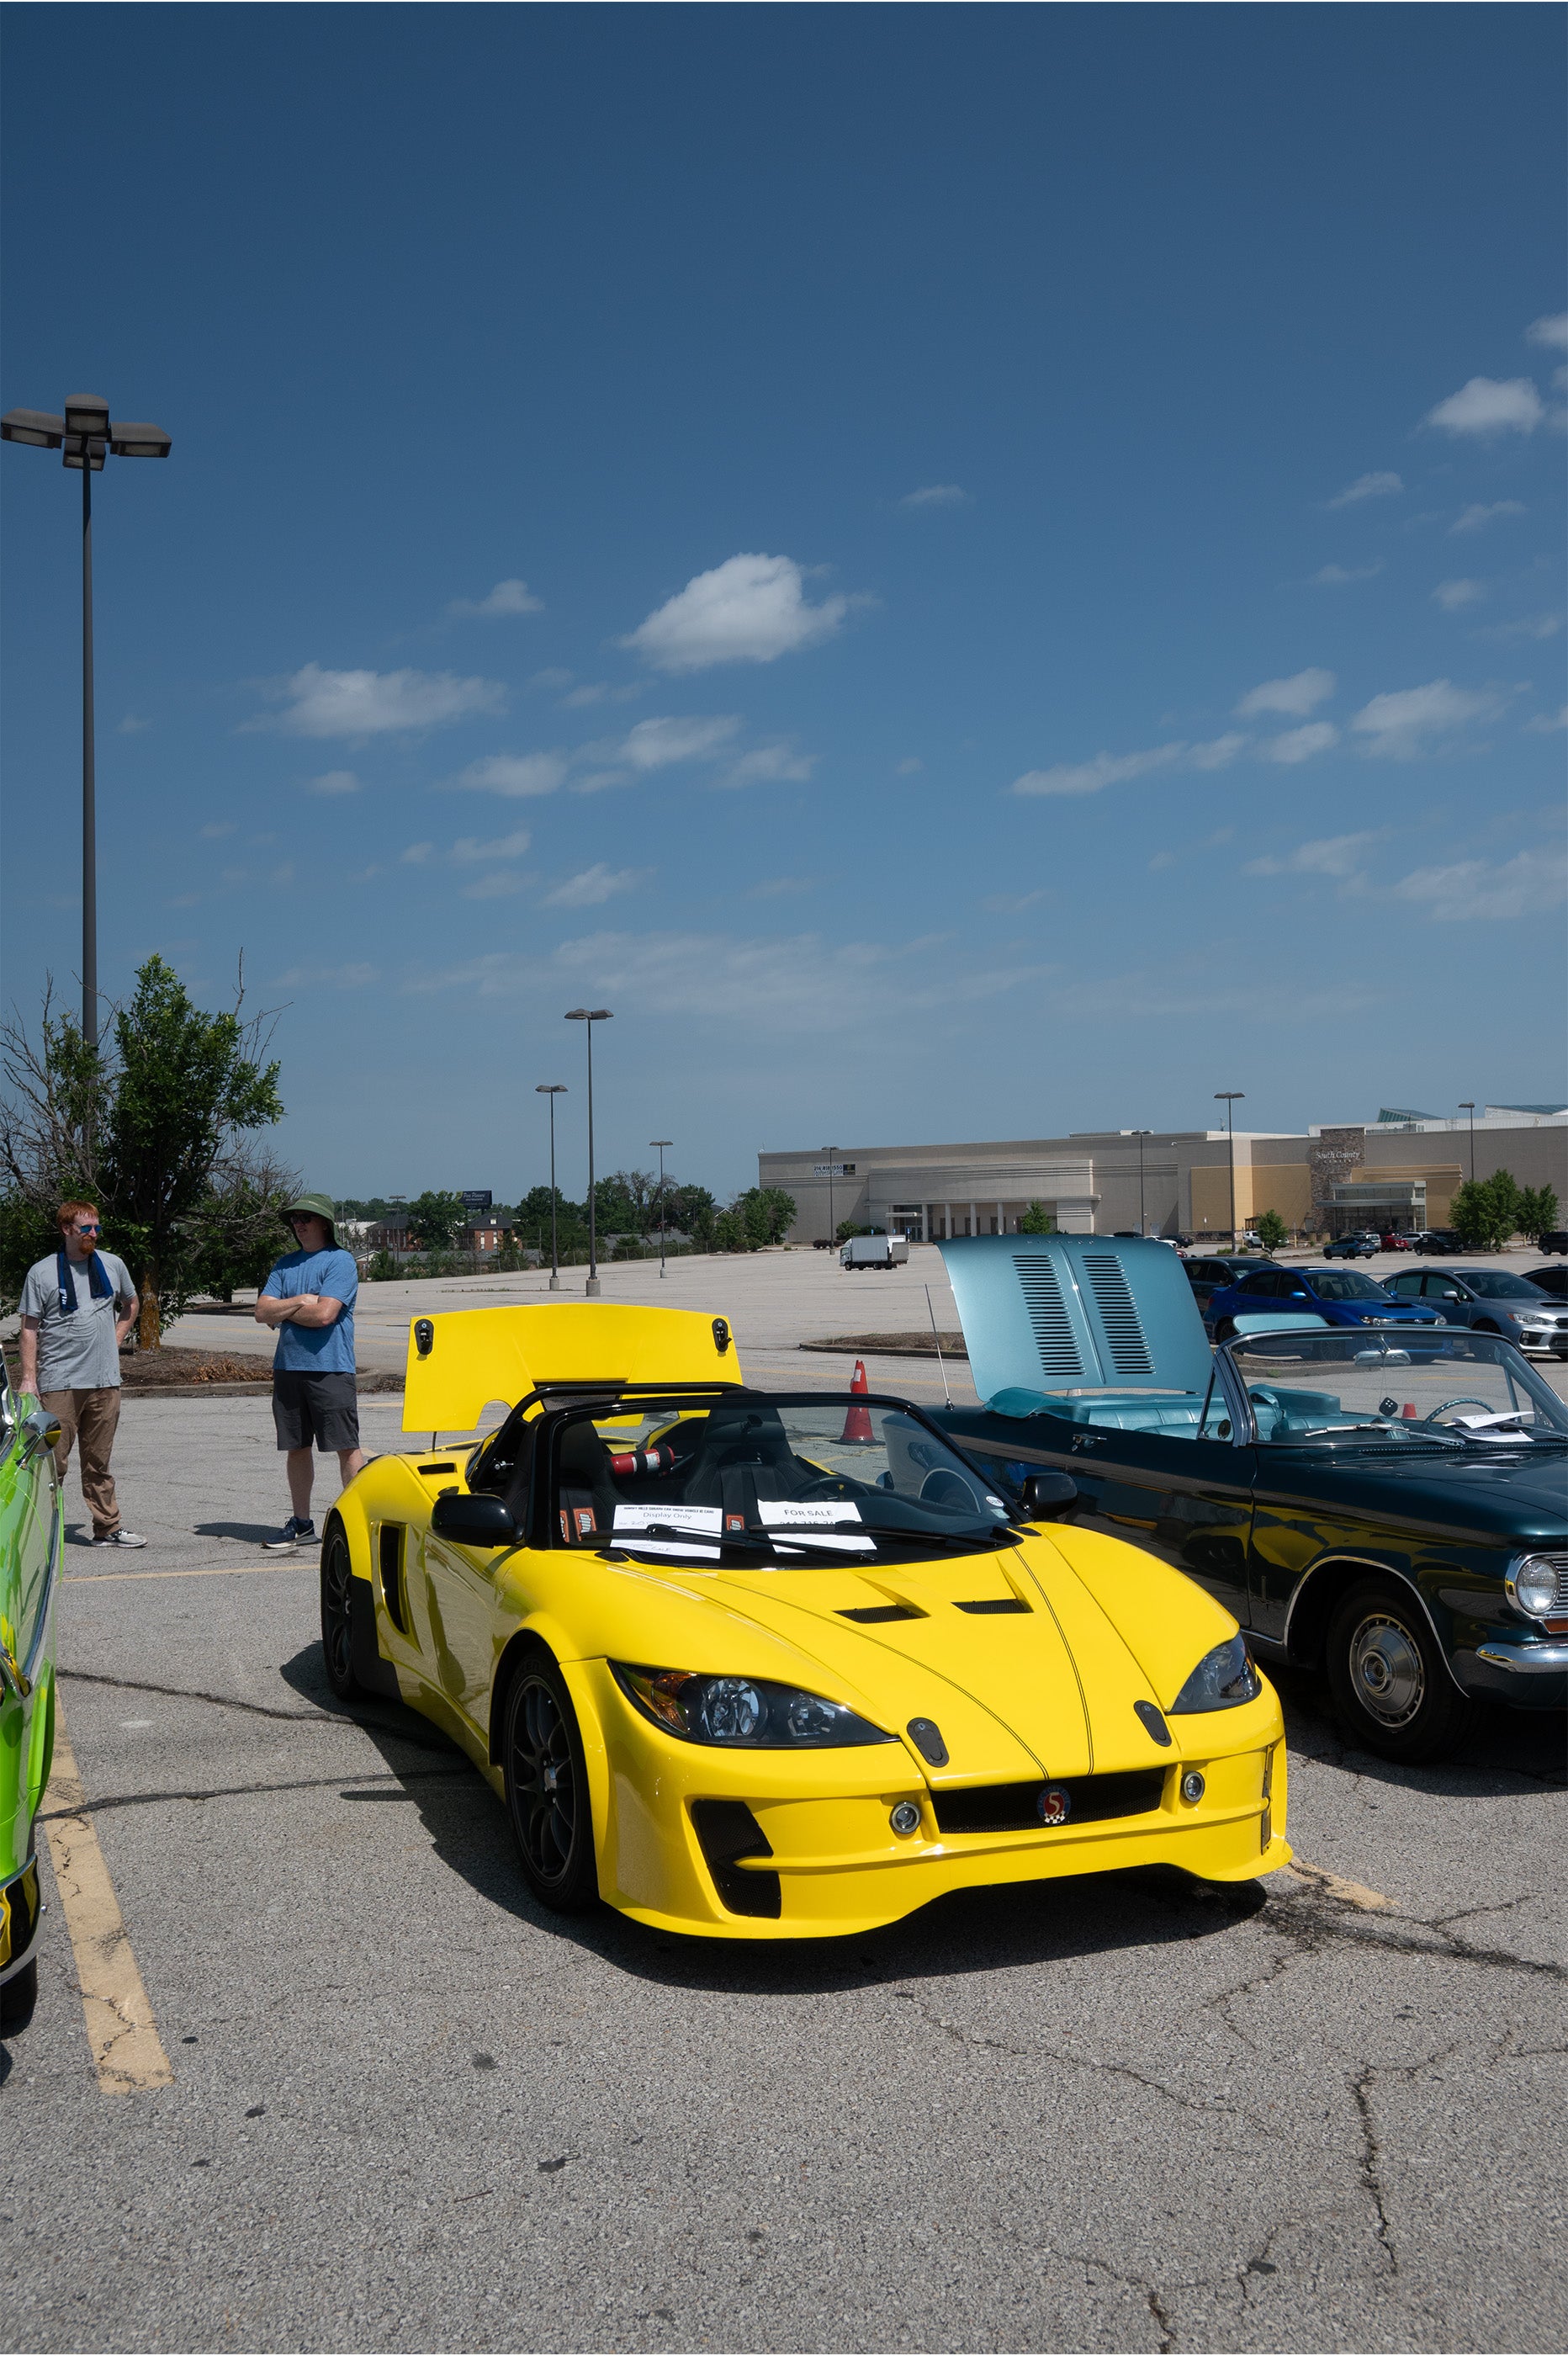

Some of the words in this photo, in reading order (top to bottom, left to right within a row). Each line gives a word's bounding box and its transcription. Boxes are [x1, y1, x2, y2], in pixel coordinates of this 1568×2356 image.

[1316, 1150, 1335, 1159] South
[1336, 1150, 1360, 1160] County
[673, 1512, 692, 1520] Only
[783, 1509, 806, 1517] FOR
